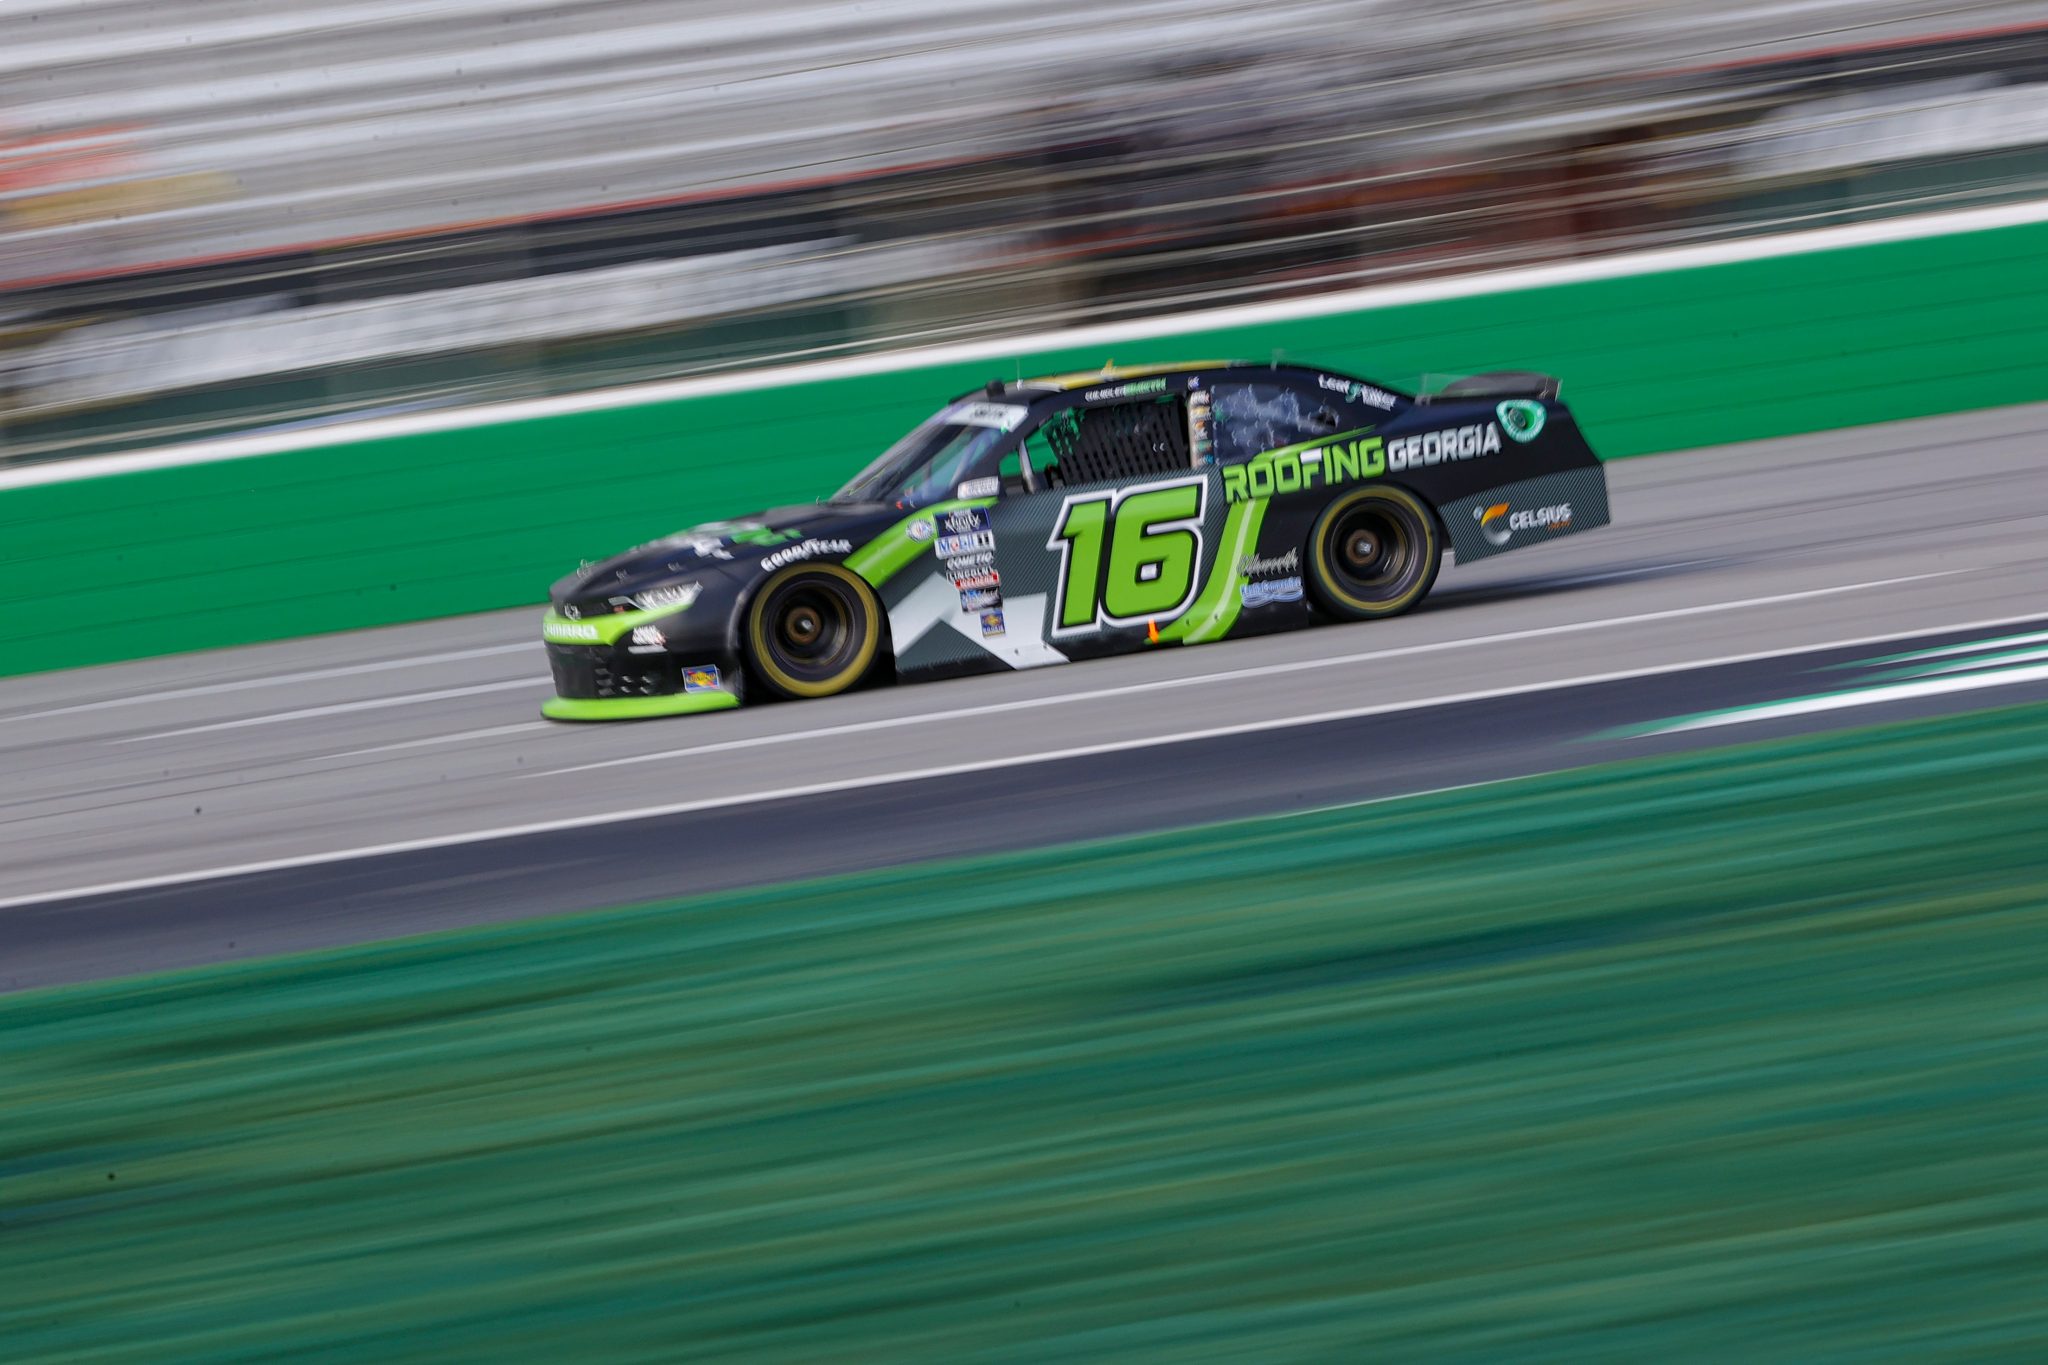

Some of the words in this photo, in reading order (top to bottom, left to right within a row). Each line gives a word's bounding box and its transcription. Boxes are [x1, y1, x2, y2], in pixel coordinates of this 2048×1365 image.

[1223, 436, 1385, 503] ROOFING
[1388, 421, 1501, 472] GEORGIA
[1509, 502, 1572, 531] CELSIUS
[761, 538, 852, 572] GOODYEAR
[1047, 475, 1207, 637] 16
